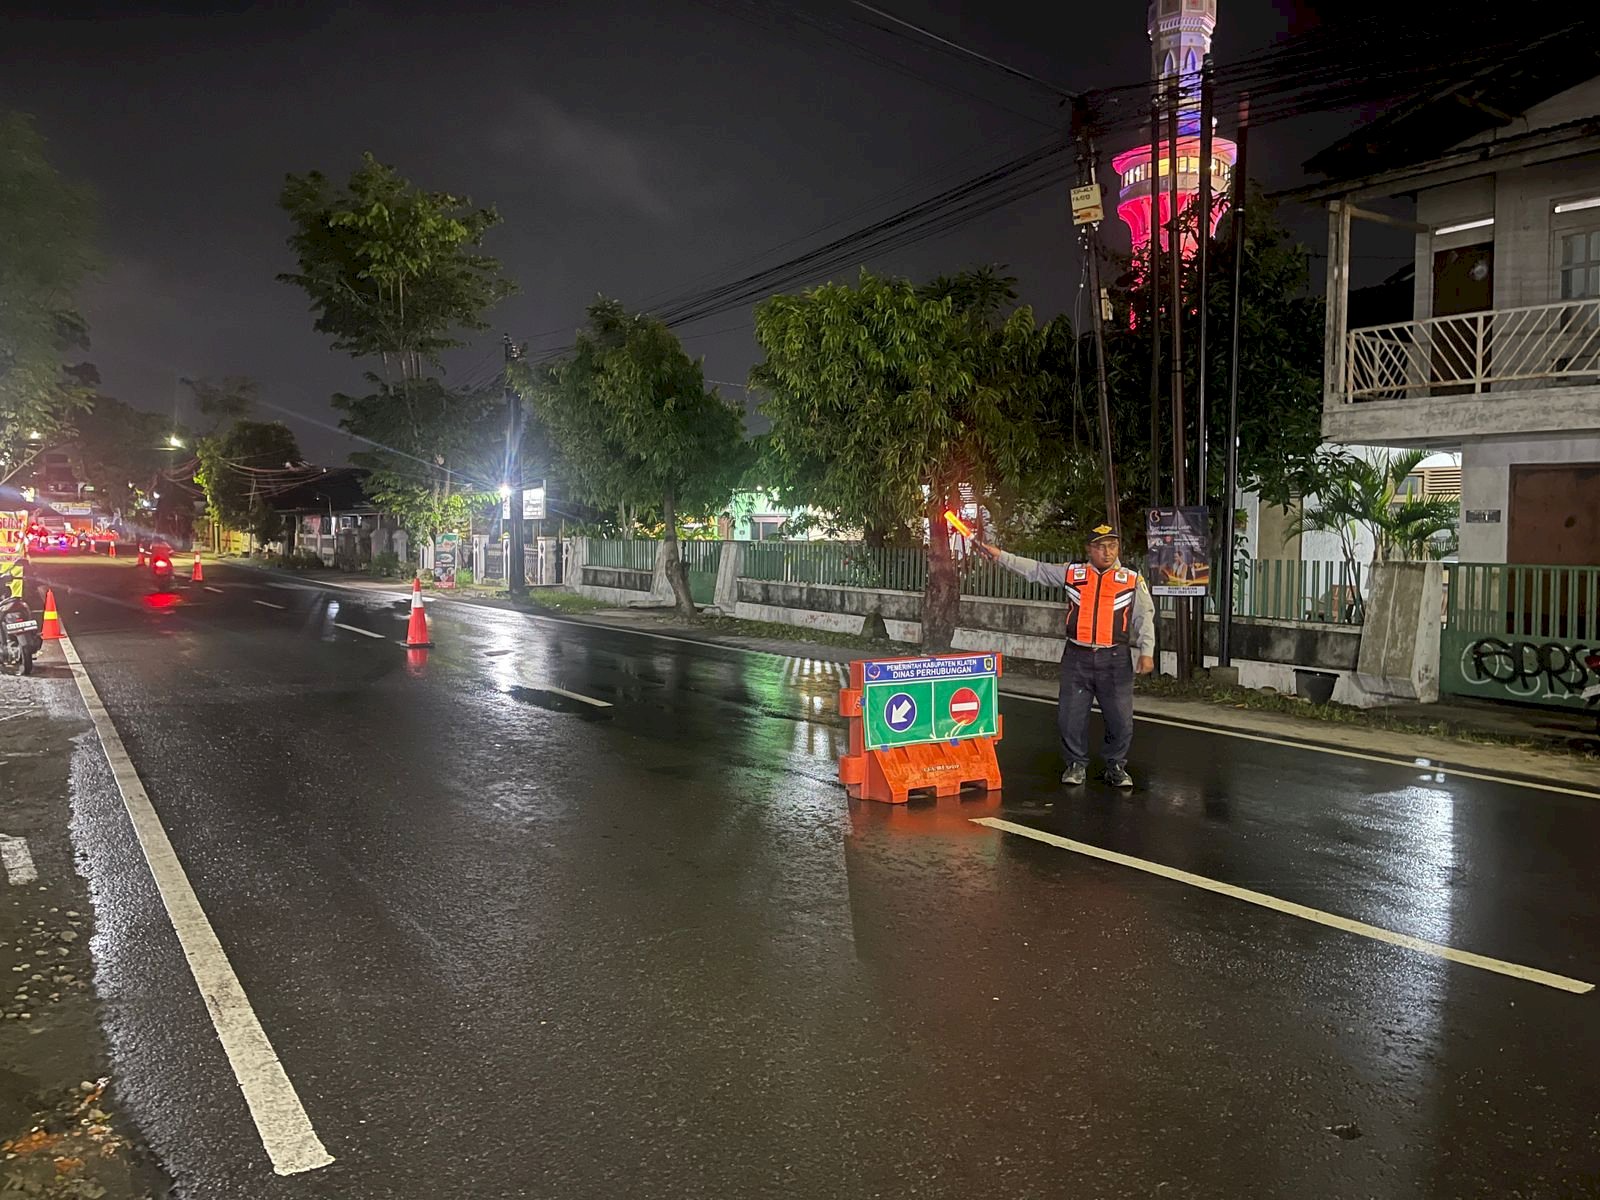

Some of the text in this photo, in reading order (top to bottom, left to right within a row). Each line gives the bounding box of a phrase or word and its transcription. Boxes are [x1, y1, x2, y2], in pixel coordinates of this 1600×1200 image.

[886, 658, 977, 672] PEMERINTAH KABUPATEN KLATEN
[892, 666, 972, 679] DINAS PERHUBUNGAN
